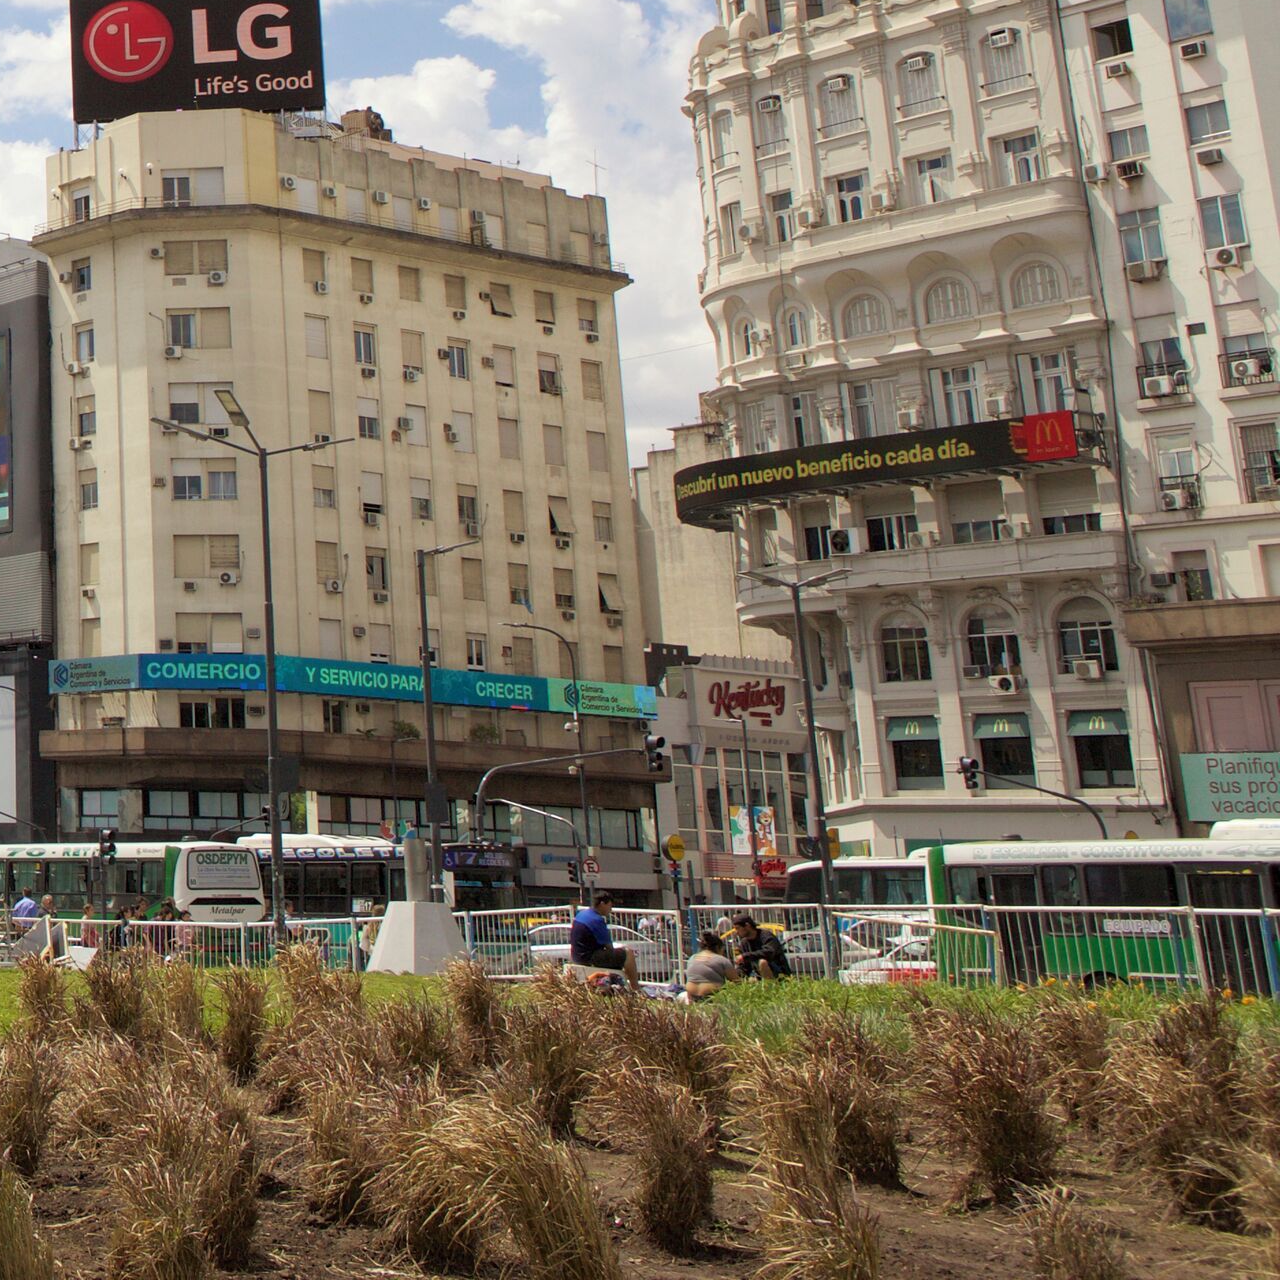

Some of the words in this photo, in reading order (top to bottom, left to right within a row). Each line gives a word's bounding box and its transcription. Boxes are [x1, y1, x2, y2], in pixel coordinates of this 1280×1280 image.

[191, 2, 292, 65] LG
[195, 74, 248, 97] Life's
[255, 70, 313, 93] Good
[676, 472, 716, 502] Descubrí
[718, 474, 739, 490] un
[741, 466, 793, 486] nuevo
[797, 450, 881, 478] beneficio
[885, 443, 934, 465] cada
[938, 438, 975, 460] día.
[70, 670, 98, 680] Argentina
[147, 662, 261, 680] COMERCIO
[70, 679, 97, 688] Comercio
[104, 677, 131, 686] Servicios
[306, 667, 316, 683] Y
[320, 668, 388, 689] SERVICIO
[391, 673, 425, 692] PARA
[476, 681, 533, 700] CRECER
[581, 702, 609, 711] Comercio
[1210, 781, 1241, 794] sus
[1248, 778, 1280, 797] pró
[6, 847, 46, 857] 70
[196, 853, 248, 865] OSDEPYM
[454, 851, 477, 865] 17
[991, 846, 1068, 859] ESCALADA
[1081, 845, 1203, 858] CONSTITUCION
[210, 906, 246, 916] Metalpar
[1104, 919, 1171, 933] EQUIPADO
